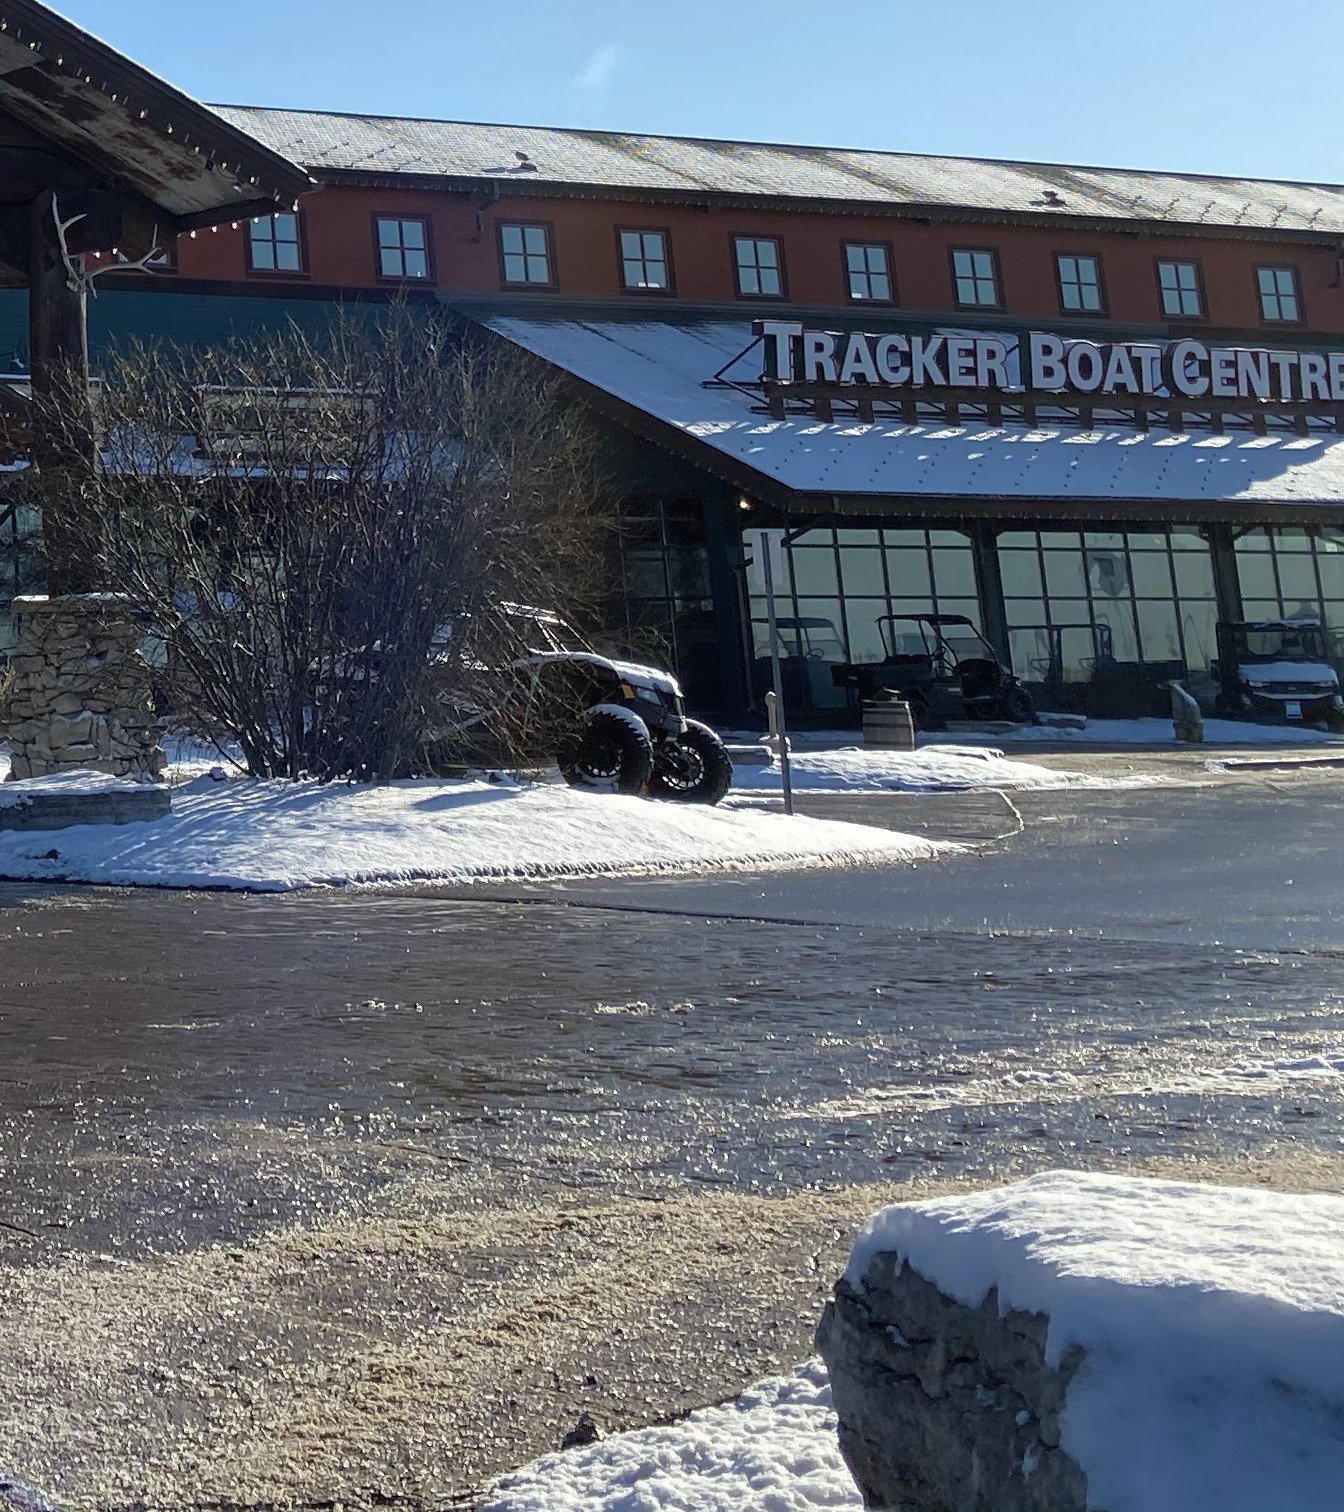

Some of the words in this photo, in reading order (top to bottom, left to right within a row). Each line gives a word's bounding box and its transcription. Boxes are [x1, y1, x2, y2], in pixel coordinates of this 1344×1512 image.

[760, 320, 1010, 389] TRACKER
[1028, 331, 1164, 396] BOAT
[1169, 338, 1344, 403] CENTRE
